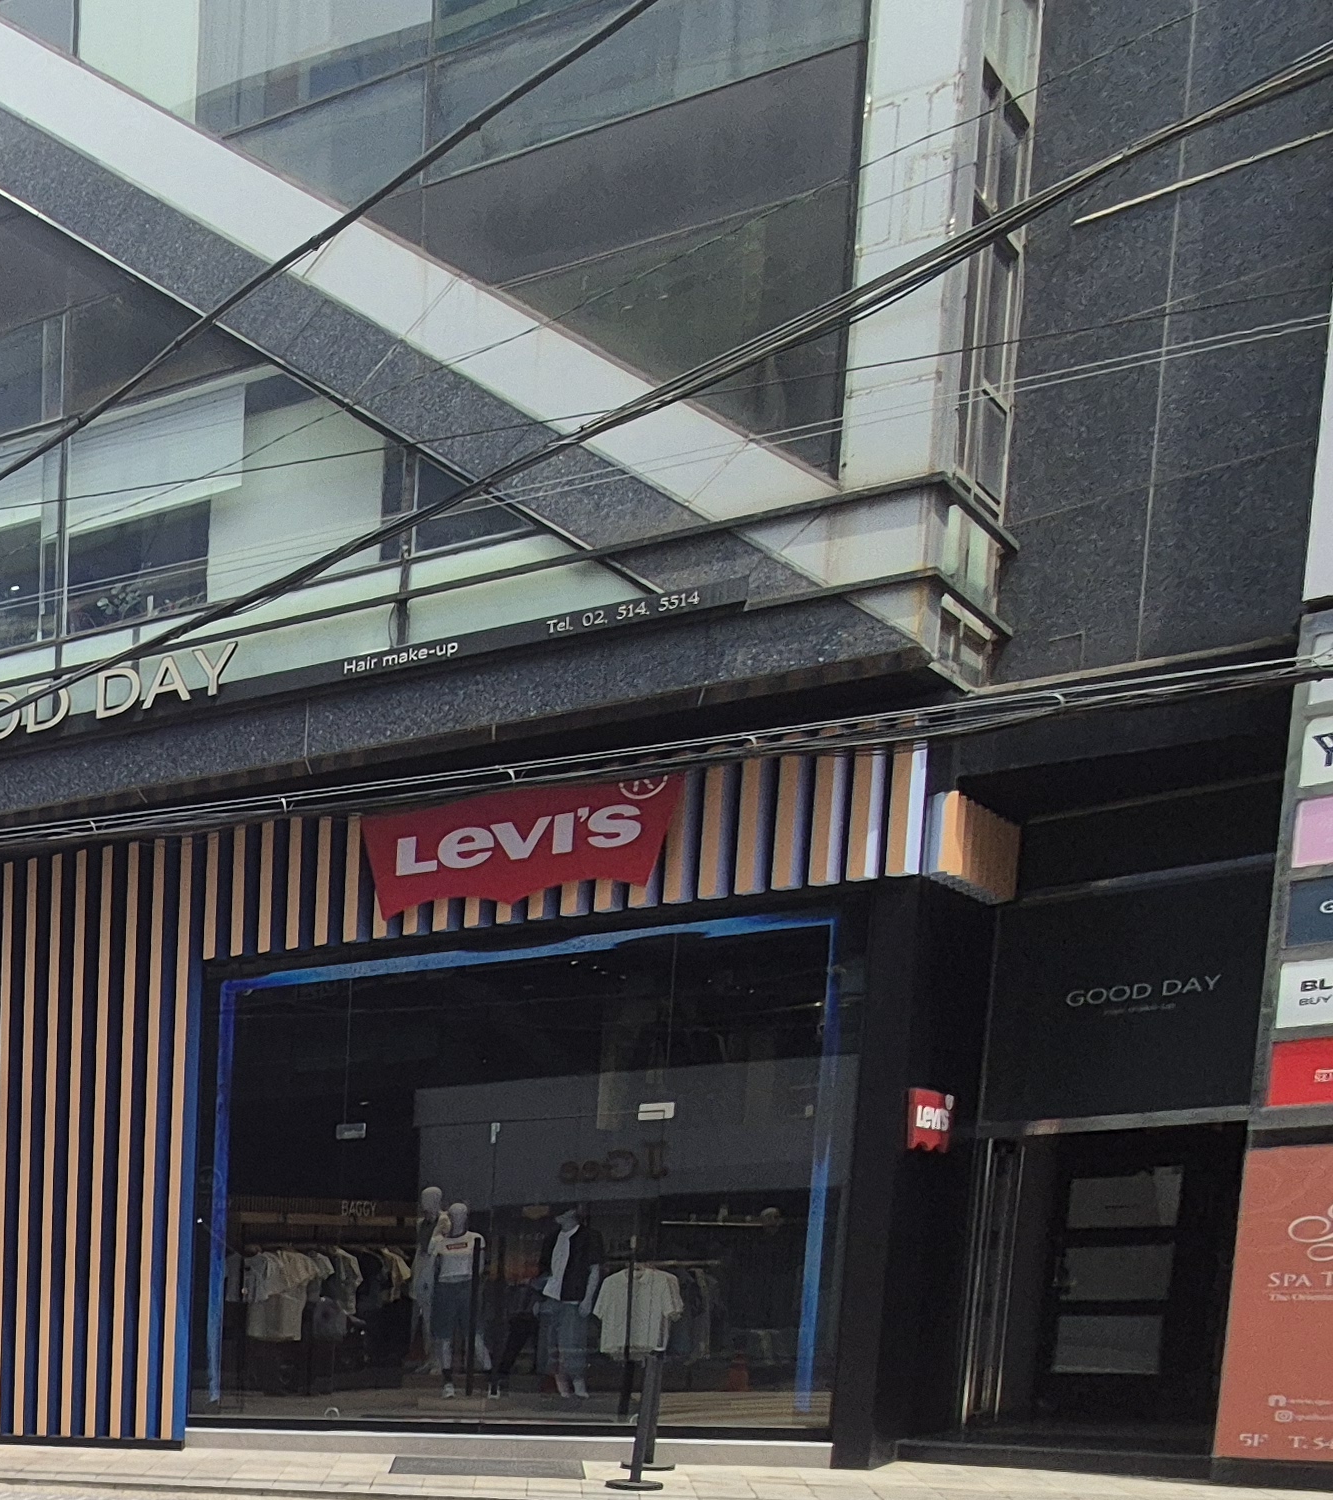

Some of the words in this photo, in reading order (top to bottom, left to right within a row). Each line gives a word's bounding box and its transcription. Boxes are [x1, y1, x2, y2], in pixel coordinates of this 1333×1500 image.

[546, 619, 574, 634] Tel.
[582, 610, 608, 627] 02.
[658, 591, 700, 612] 5514
[343, 655, 378, 675] Hair
[382, 641, 459, 668] make-up
[95, 641, 239, 720] DAY
[1065, 983, 1152, 1007] GOOD
[1162, 974, 1222, 996] DAY
[1299, 995, 1332, 1006] BUY
[341, 1200, 377, 1216] BAGGY
[1267, 1271, 1312, 1287] SPA
